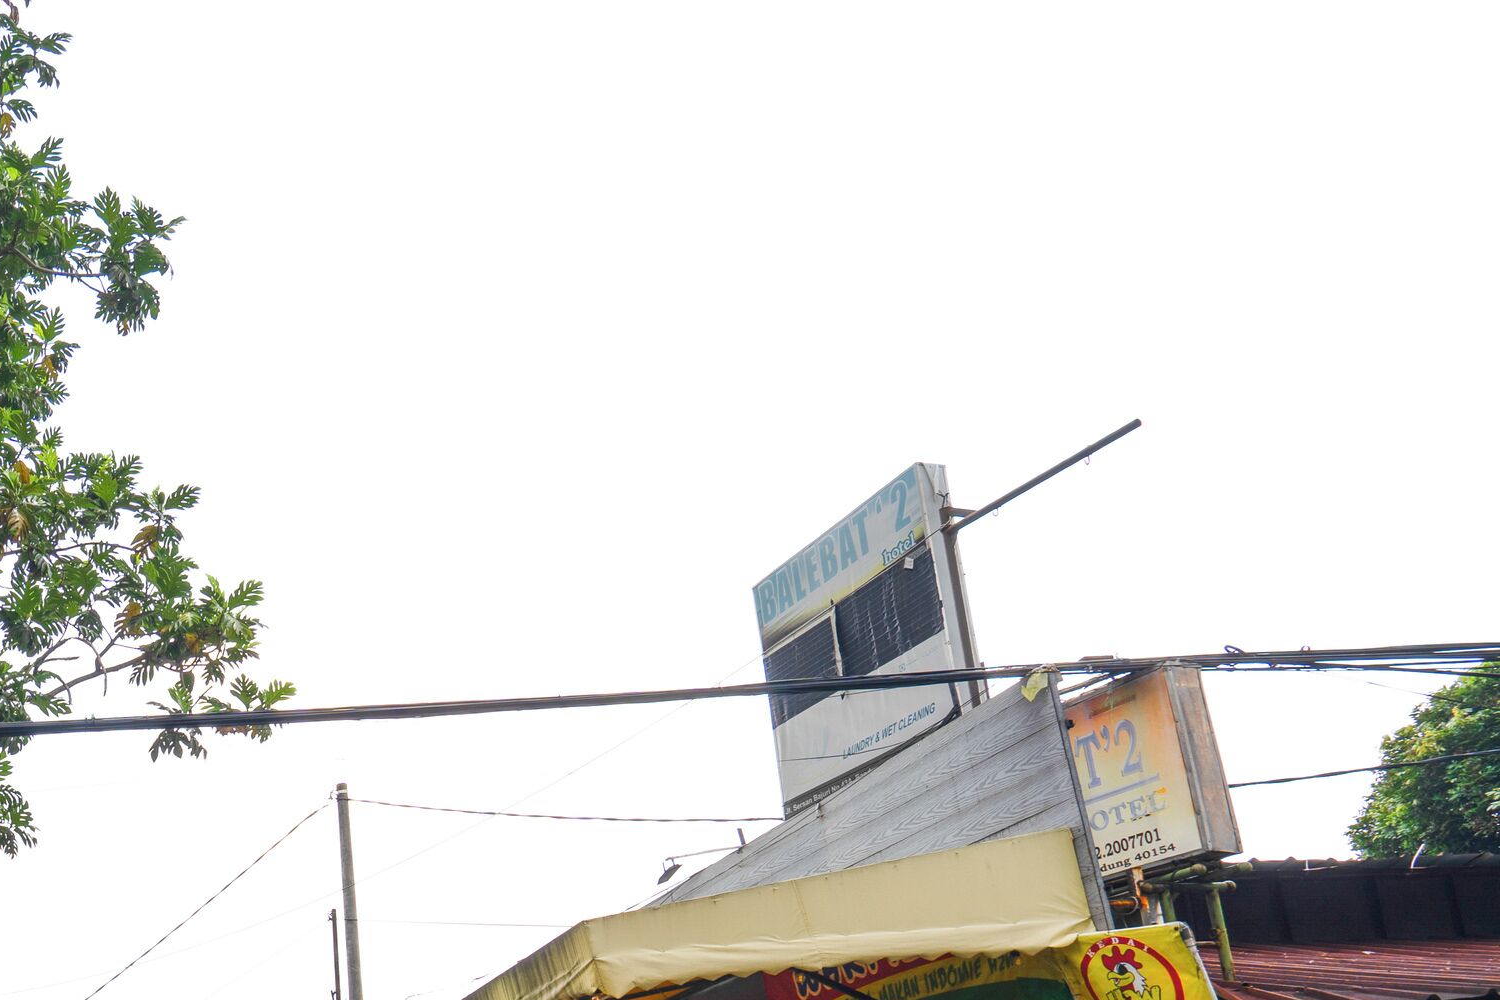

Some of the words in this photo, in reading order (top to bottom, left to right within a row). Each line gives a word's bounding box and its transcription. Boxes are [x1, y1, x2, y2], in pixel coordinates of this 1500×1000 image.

[882, 531, 916, 566] hotel
[842, 735, 875, 760] LAUNDRY
[874, 731, 881, 743] &
[881, 723, 898, 740] WET
[898, 702, 936, 731] CLEANING
[1090, 791, 1168, 832] OTEL
[1134, 842, 1176, 862] 40154
[1086, 937, 1151, 958] KEDAI
